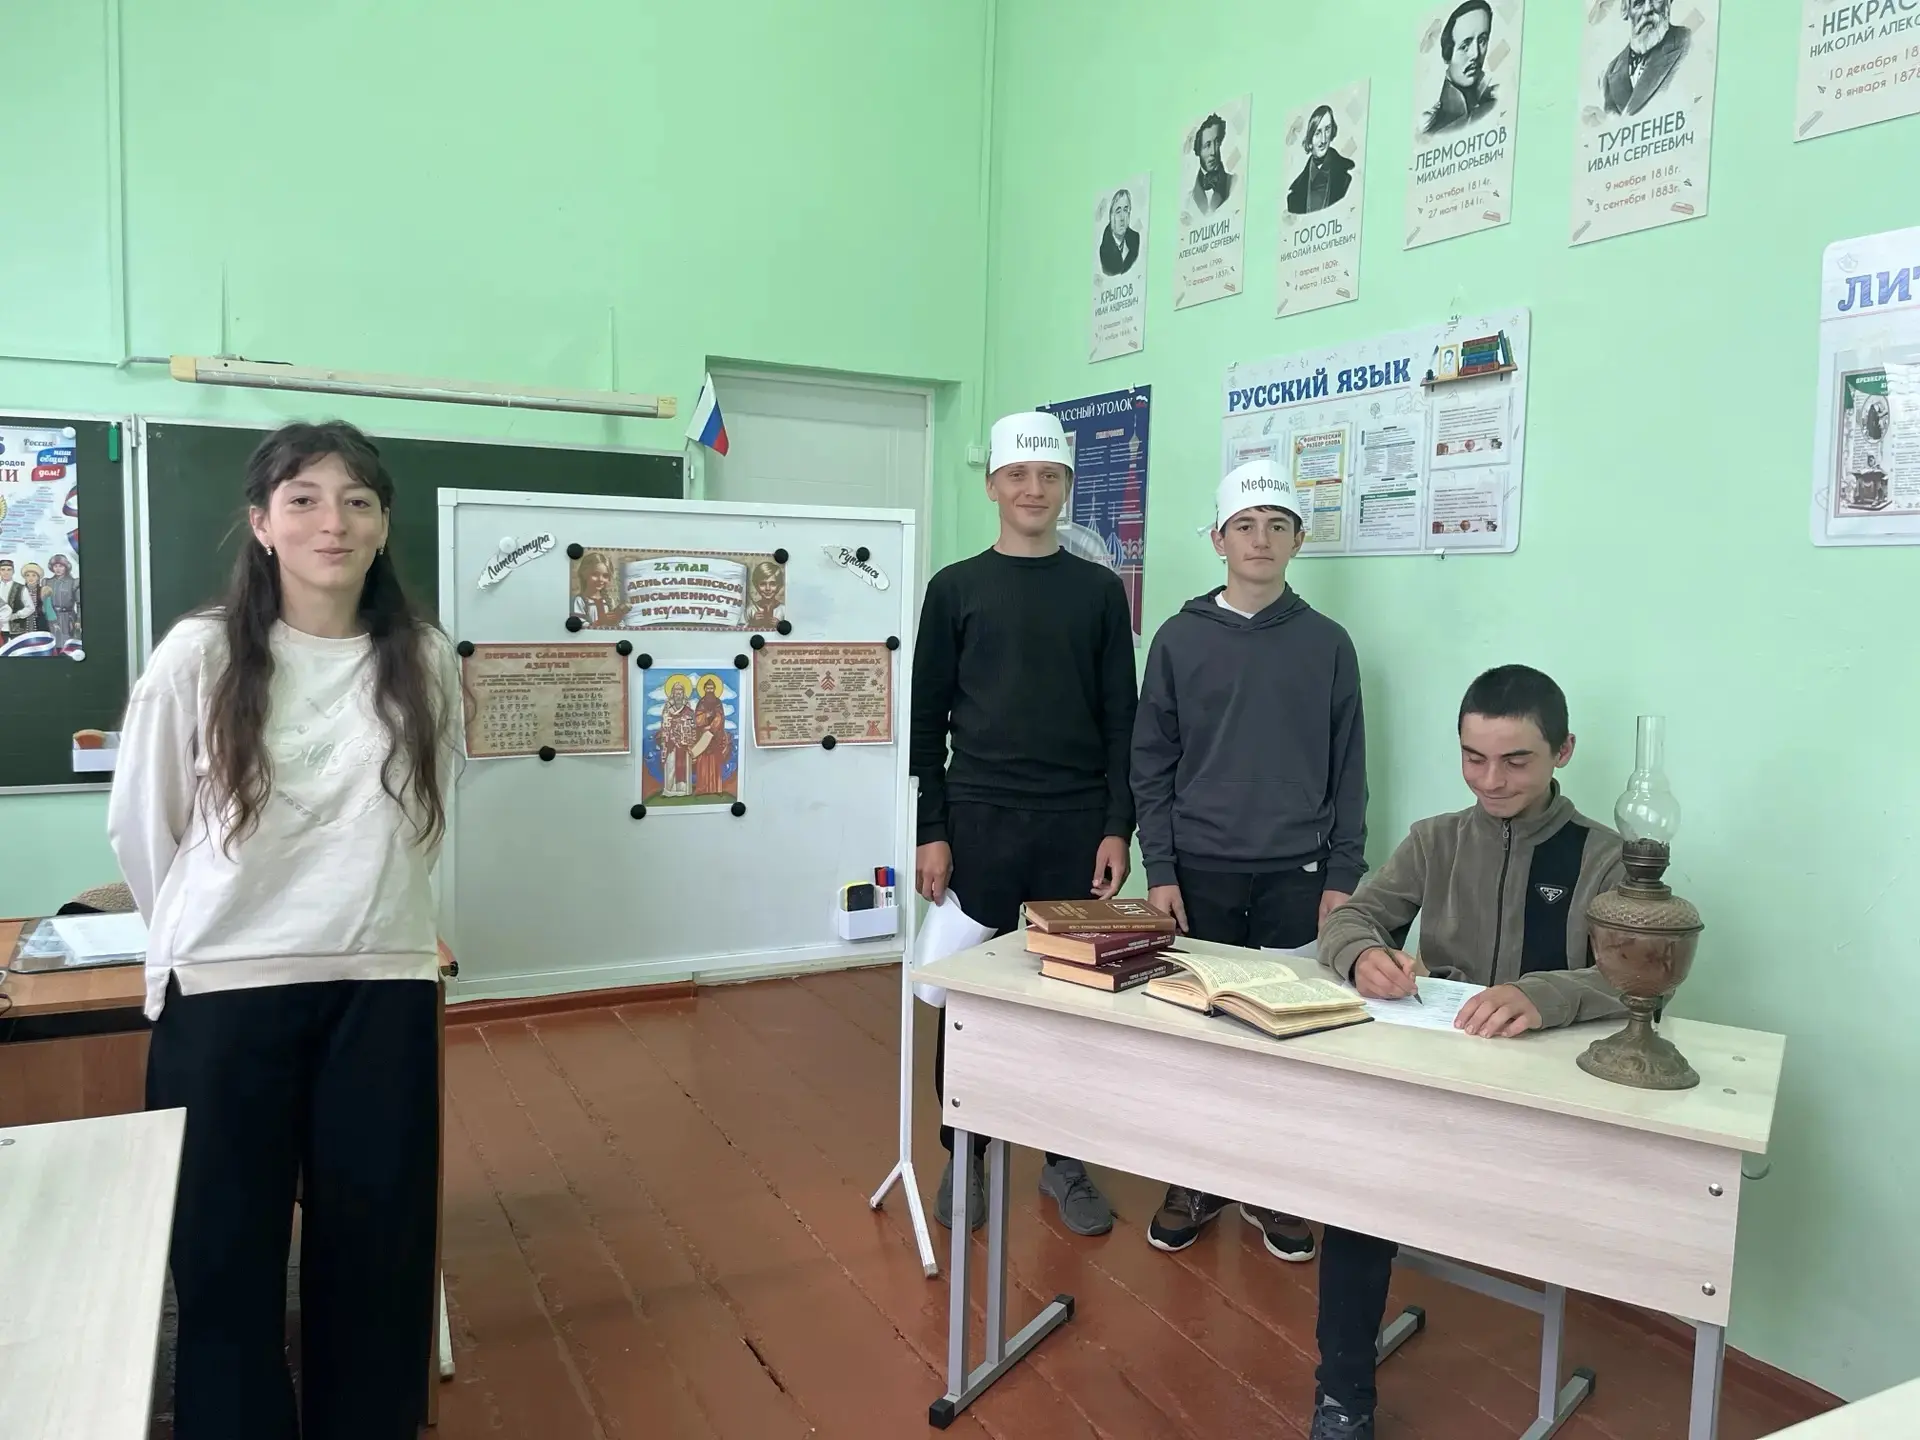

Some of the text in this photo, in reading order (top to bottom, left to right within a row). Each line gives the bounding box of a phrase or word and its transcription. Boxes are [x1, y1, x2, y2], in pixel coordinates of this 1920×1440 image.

[1810, 13, 1920, 58] НИКОЛАЙ АЛЕКС
[1829, 67, 1843, 80] 10
[1846, 56, 1898, 78] декабря
[1834, 88, 1842, 99] 8
[1846, 79, 1887, 97] января
[1598, 110, 1686, 152] ТУРГЕНЕВ
[1415, 126, 1507, 171] ЛЕРМОНТОВ
[1588, 131, 1694, 172] ИВАН СЕРГЕЕВИЧ
[1417, 148, 1504, 185] МИХАИЛ ЮРЬЕВИЧ
[1436, 186, 1464, 201] октября
[1605, 182, 1612, 191] 9
[1614, 175, 1646, 190] ноября
[1428, 208, 1438, 219] 27
[1595, 203, 1601, 213] 3
[1603, 194, 1646, 211] сентября
[1189, 218, 1231, 245] ПУШКИН
[1294, 219, 1343, 247] ГОГОЛЬ
[1179, 232, 1241, 259] АЛЕКСАНДР СЕРГЕЕВИЧ
[1281, 232, 1356, 262] НИКОЛАЙ ВАСИЛЬЕВИЧ
[1100, 283, 1134, 305] КРЫЛОВ
[1837, 266, 1920, 311] ЛИ
[1228, 357, 1411, 412] РУССКИЙ ЯЗЫК
[1052, 397, 1133, 421] АССНЫЙ УГОЛОК
[1016, 433, 1060, 451] Кирилл
[40, 455, 68, 464] общий
[39, 469, 60, 477] дом!
[1241, 476, 1291, 495] Мефодий
[487, 534, 551, 580] Литература
[674, 563, 709, 572] МАЯ
[839, 548, 879, 578] Рукопись
[627, 577, 744, 594] ДЕНЬ СЛАВЯНСКОЙ
[630, 592, 743, 607] ПИСЬМЕННОСТИ
[641, 605, 728, 620] И КУЛЬТУРЫ
[524, 661, 570, 672] АЗБУКИ
